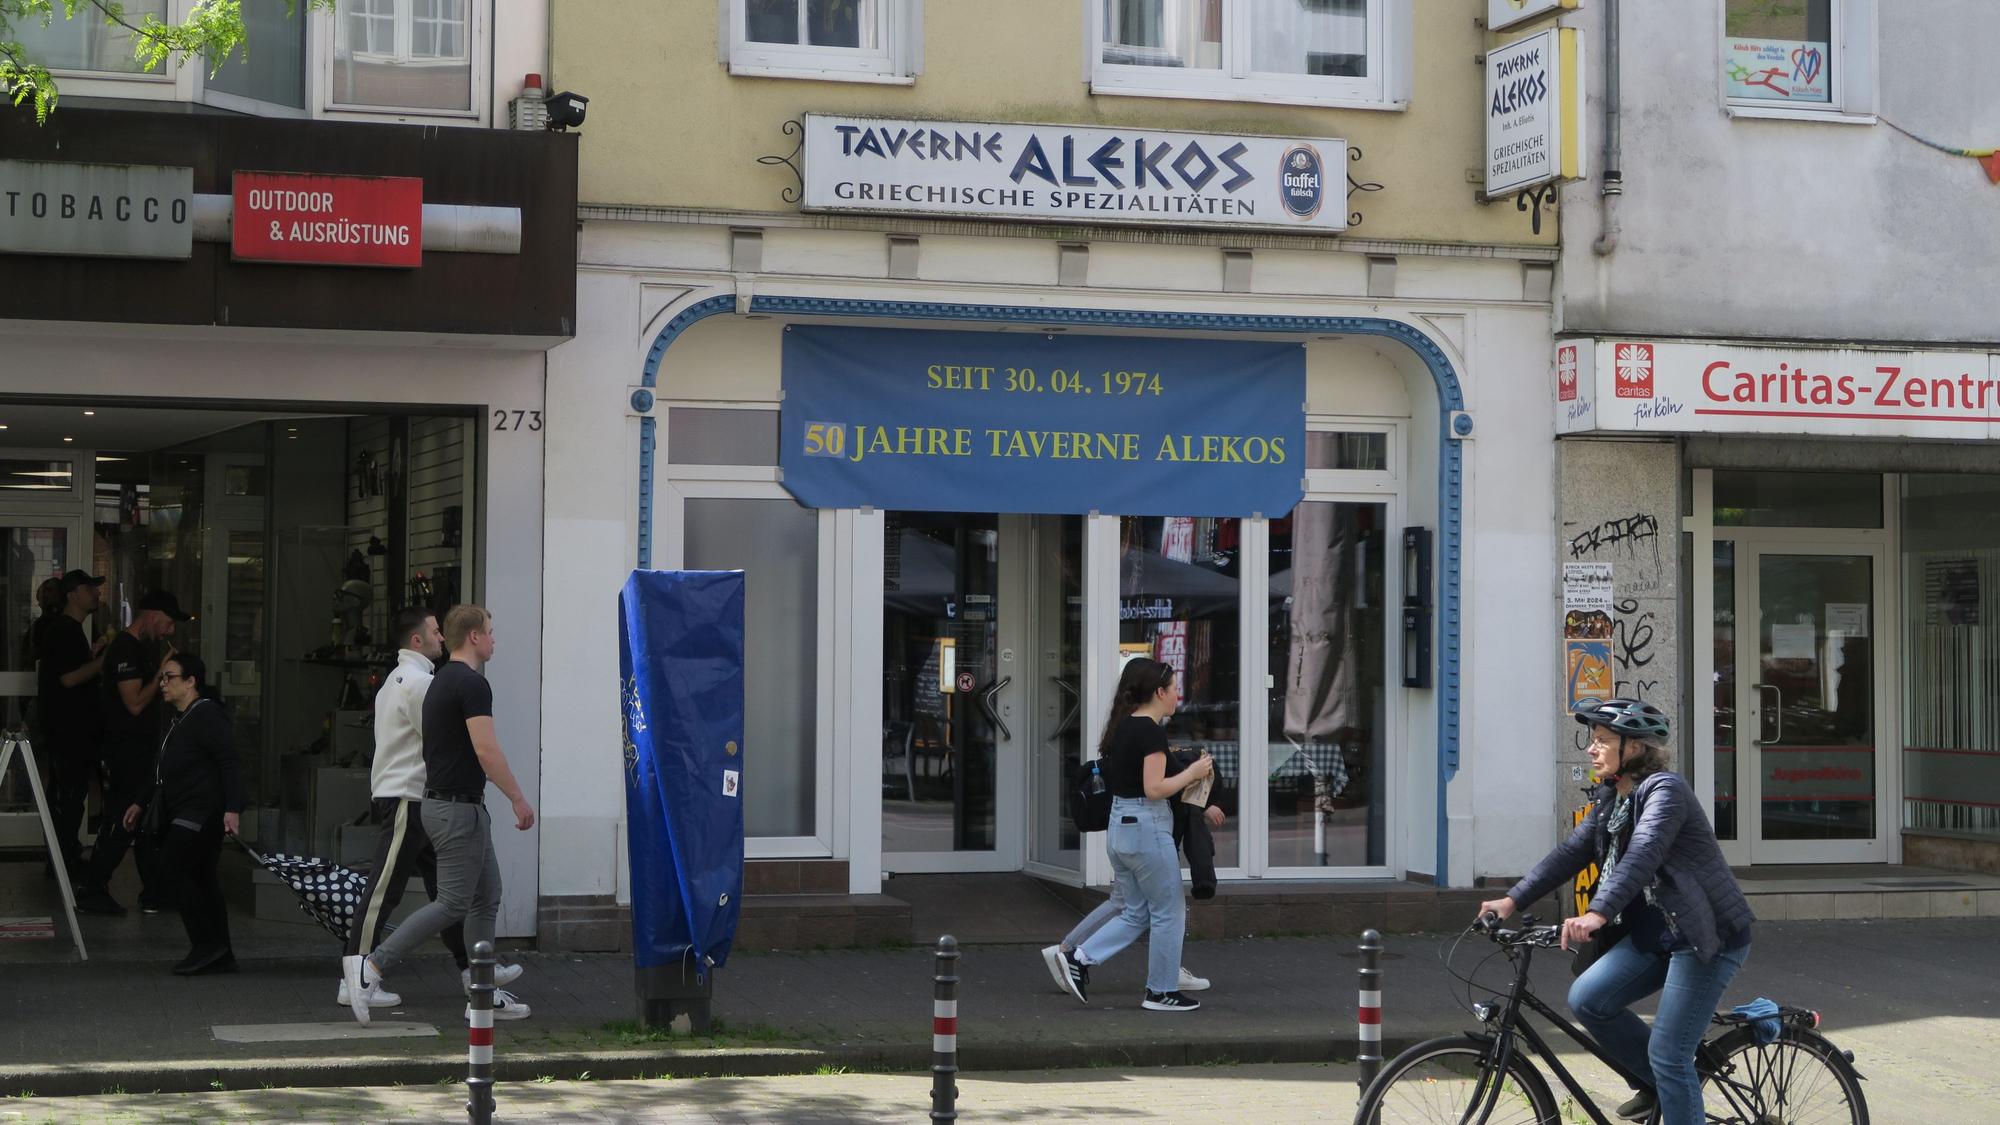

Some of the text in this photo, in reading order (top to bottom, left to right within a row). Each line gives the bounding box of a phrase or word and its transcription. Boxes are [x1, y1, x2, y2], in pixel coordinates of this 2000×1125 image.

[1496, 48, 1539, 79] TAVERNE
[1491, 69, 1547, 118] ALEKOS
[834, 125, 1256, 194] TAVERNE ALEKOS
[1494, 134, 1543, 161] GRIECHISCHE
[1492, 149, 1546, 176] SPEZIALITÄTEN
[1284, 172, 1320, 189] Gaffel
[1290, 188, 1313, 198] Kölsch
[6, 191, 187, 224] TOBACCO
[249, 189, 334, 213] OUTDOOR
[834, 181, 1035, 207] GRIECHISCHE
[1050, 191, 1255, 215] SPEZIALITÄTEN
[269, 217, 410, 246] & AUSRÜSTUNG
[927, 364, 1164, 396] SEIT 30. 04. 1974
[1617, 387, 1651, 398] caritas
[494, 409, 542, 432] 273
[1634, 403, 1652, 427] für
[805, 424, 1286, 464] 50 JAHRE TAVERNE ALEKOS
